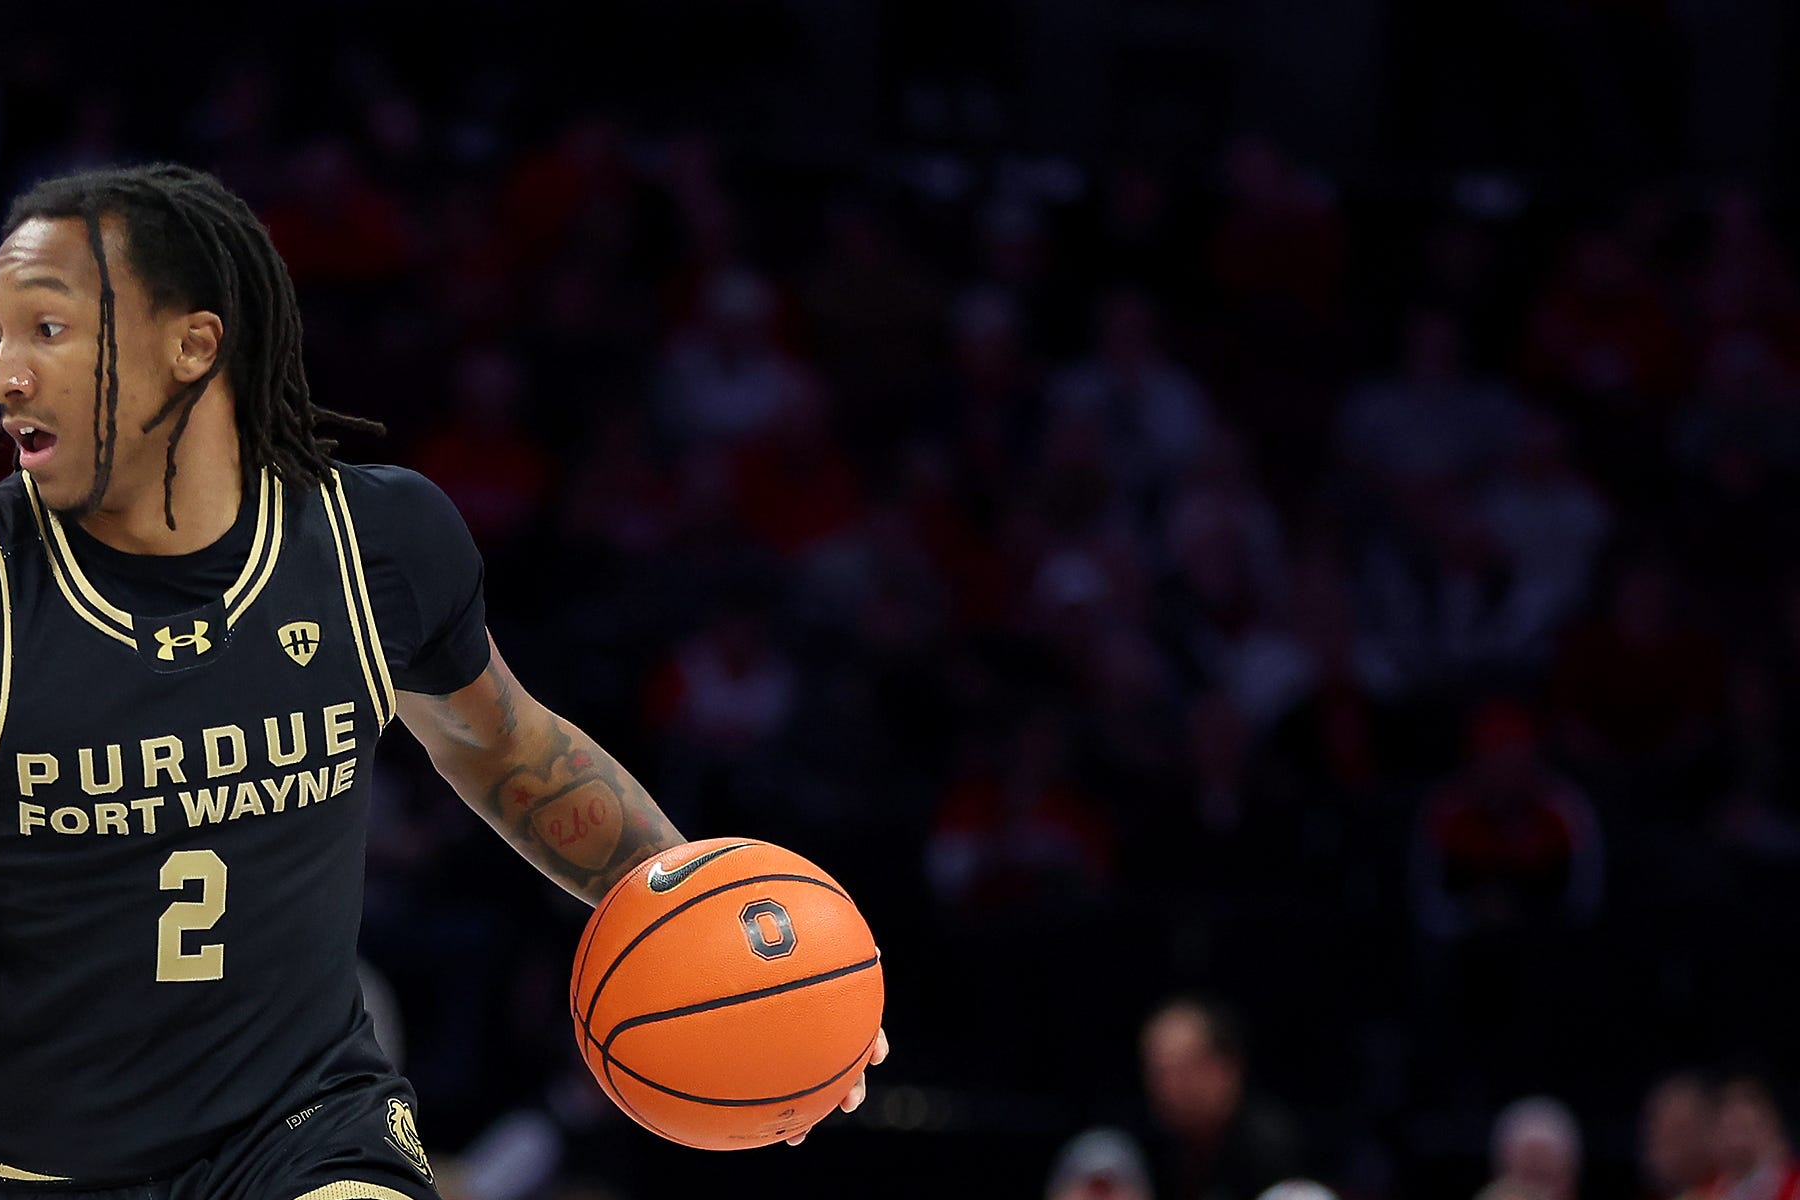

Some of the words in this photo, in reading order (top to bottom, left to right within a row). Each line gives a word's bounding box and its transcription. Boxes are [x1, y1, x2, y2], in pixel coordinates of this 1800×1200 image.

[16, 701, 358, 798] PURDUE
[18, 796, 166, 836] FORT
[177, 757, 358, 828] WAYNE
[155, 849, 228, 982] 2
